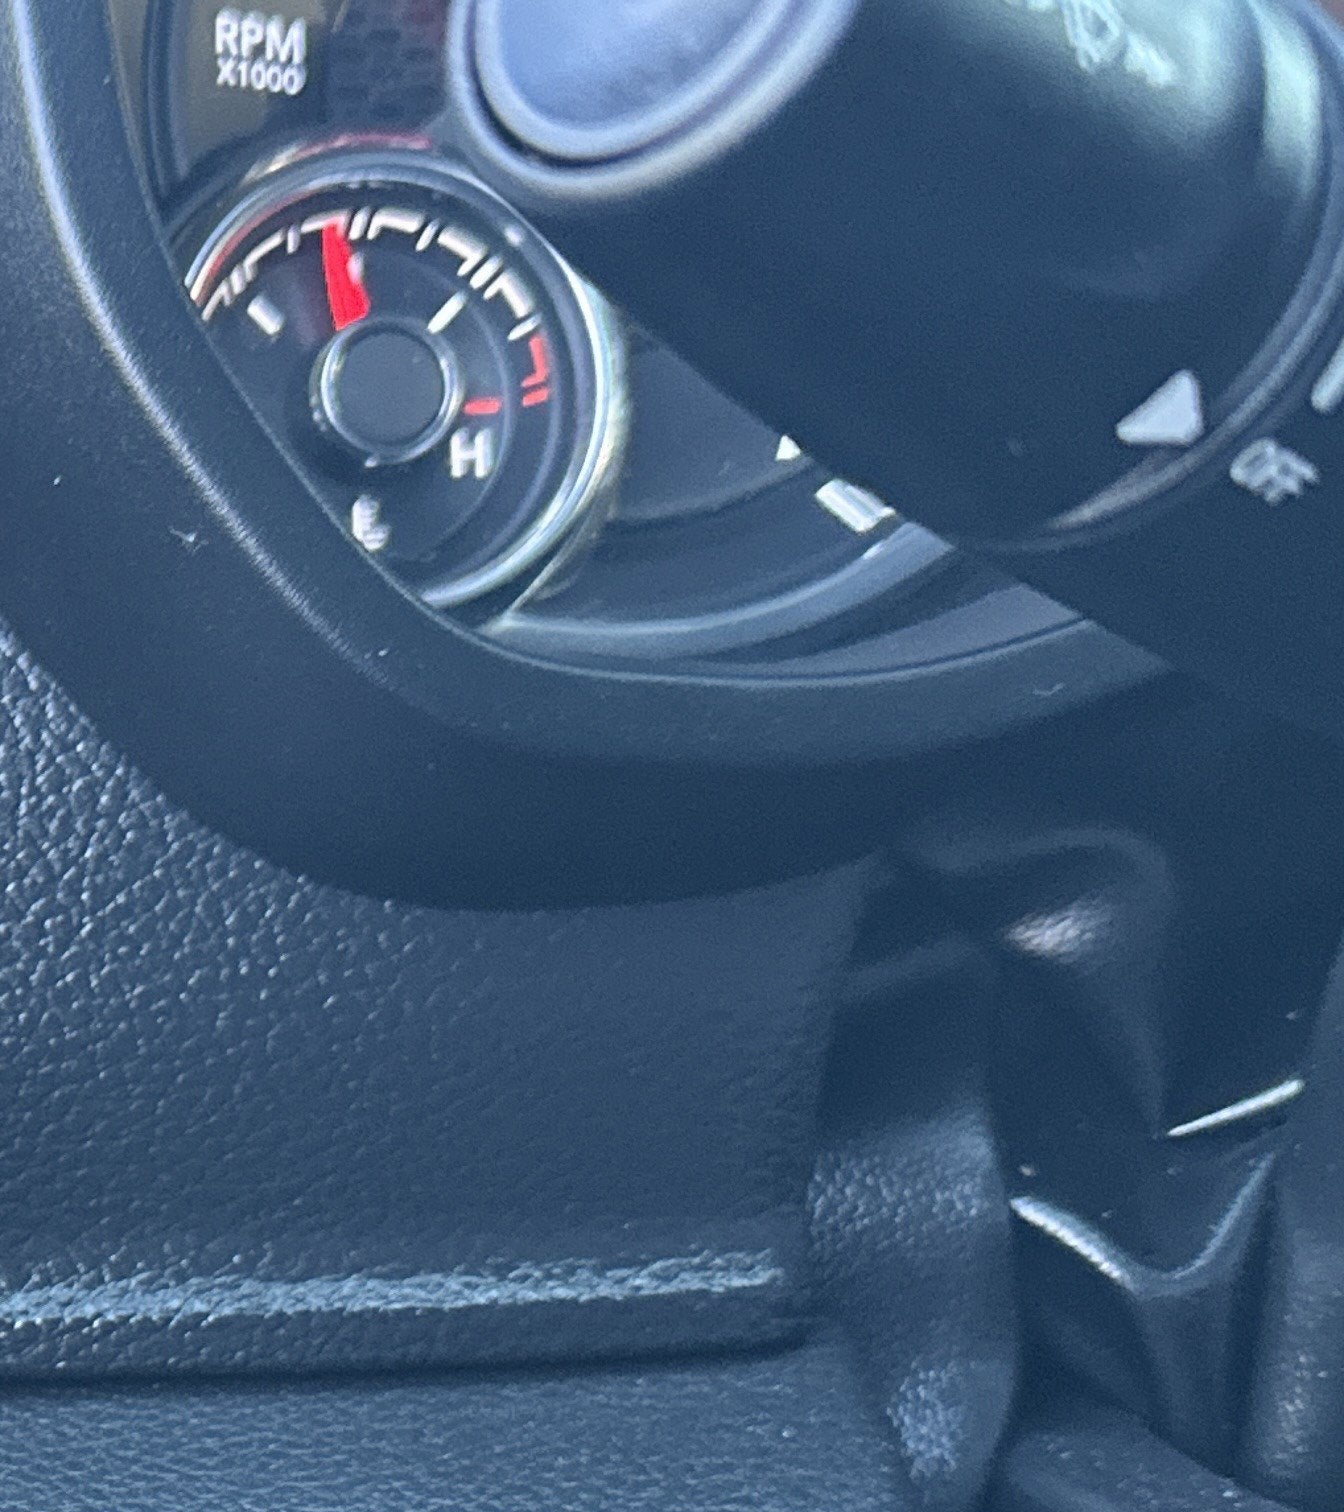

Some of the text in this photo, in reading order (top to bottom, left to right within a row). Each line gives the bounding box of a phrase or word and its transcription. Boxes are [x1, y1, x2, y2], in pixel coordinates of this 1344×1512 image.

[215, 8, 307, 63] RPM
[216, 57, 307, 95] X1000
[449, 428, 495, 479] H
